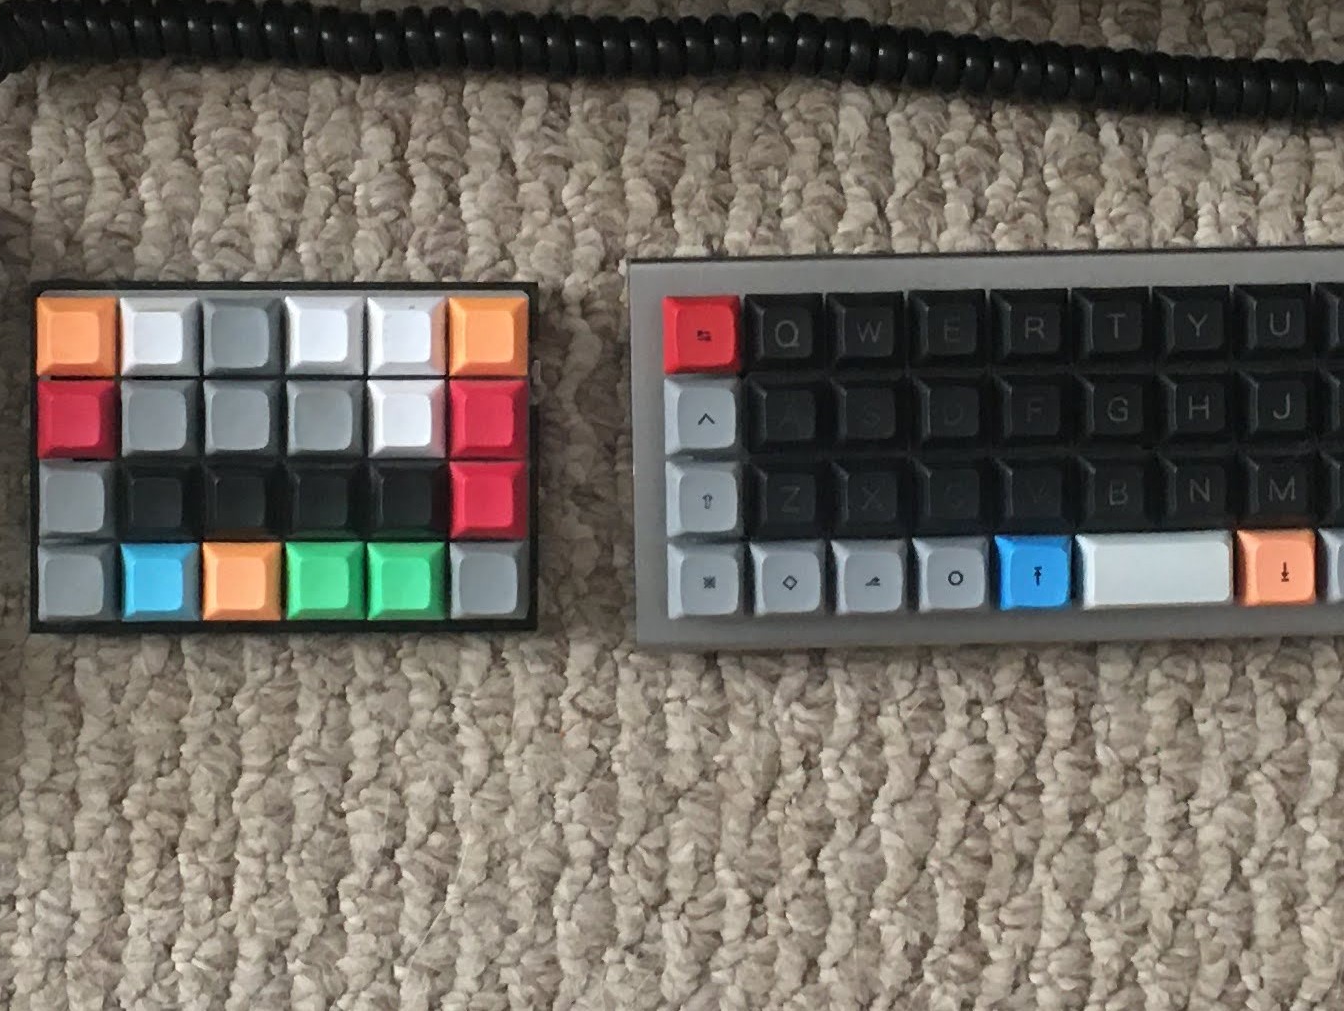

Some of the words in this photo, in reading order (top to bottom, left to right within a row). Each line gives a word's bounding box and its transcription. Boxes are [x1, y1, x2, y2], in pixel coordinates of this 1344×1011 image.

[774, 320, 800, 348] Q
[858, 320, 883, 344] W
[943, 318, 961, 344] E
[1025, 317, 1046, 340] R
[1106, 312, 1127, 339] T
[1187, 313, 1208, 337] Y
[1269, 310, 1291, 337] U
[1025, 397, 1042, 423] F
[1107, 397, 1129, 423] G
[1188, 395, 1210, 420] H
[1272, 393, 1291, 420] J
[780, 486, 802, 513] Z
[860, 486, 887, 512] X
[1108, 483, 1129, 506] B
[1189, 478, 1211, 503] N
[1268, 476, 1297, 501] M
